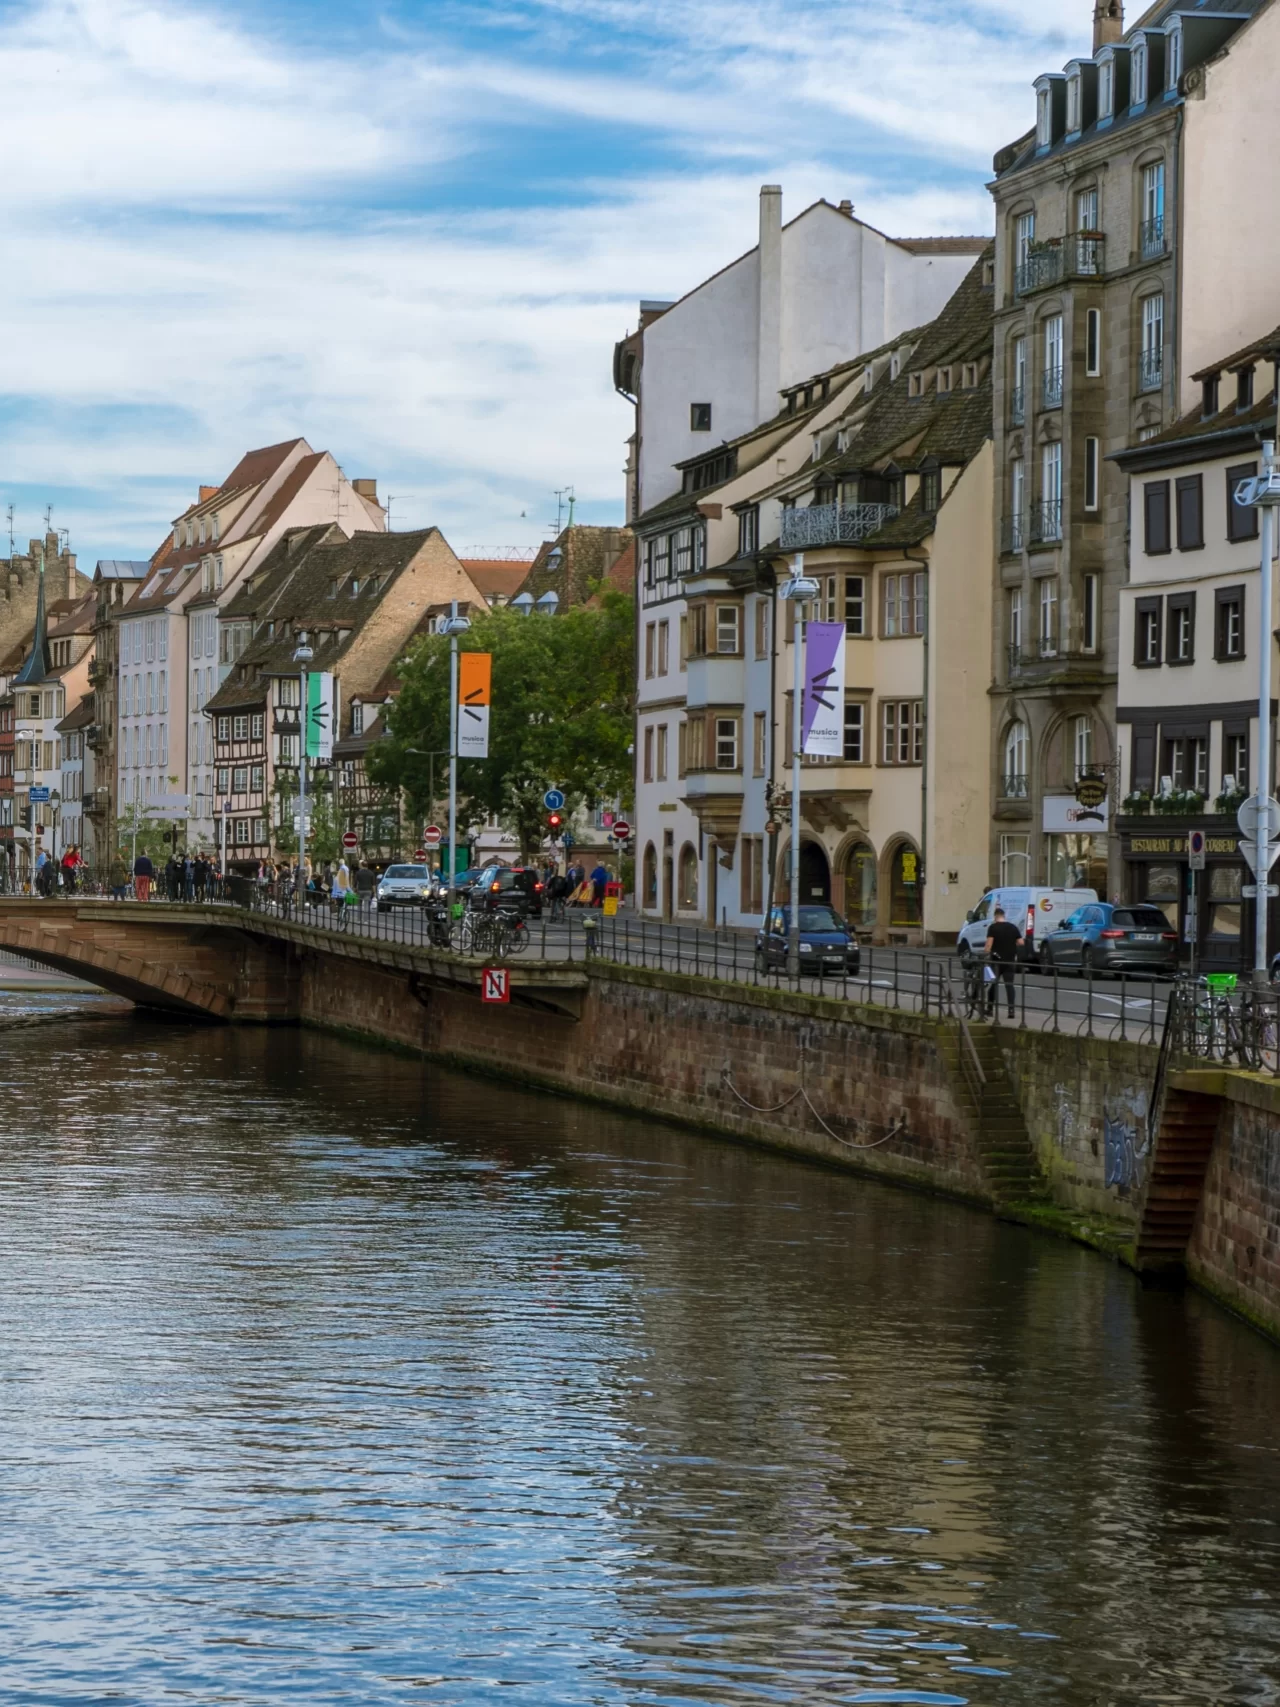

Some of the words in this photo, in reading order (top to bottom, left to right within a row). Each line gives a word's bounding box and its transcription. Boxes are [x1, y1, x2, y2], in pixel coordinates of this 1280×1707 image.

[808, 728, 838, 736] musica
[1131, 839, 1170, 852] RESTAURANT
[1173, 839, 1183, 852] AU
[1205, 839, 1236, 852] CORBEAU
